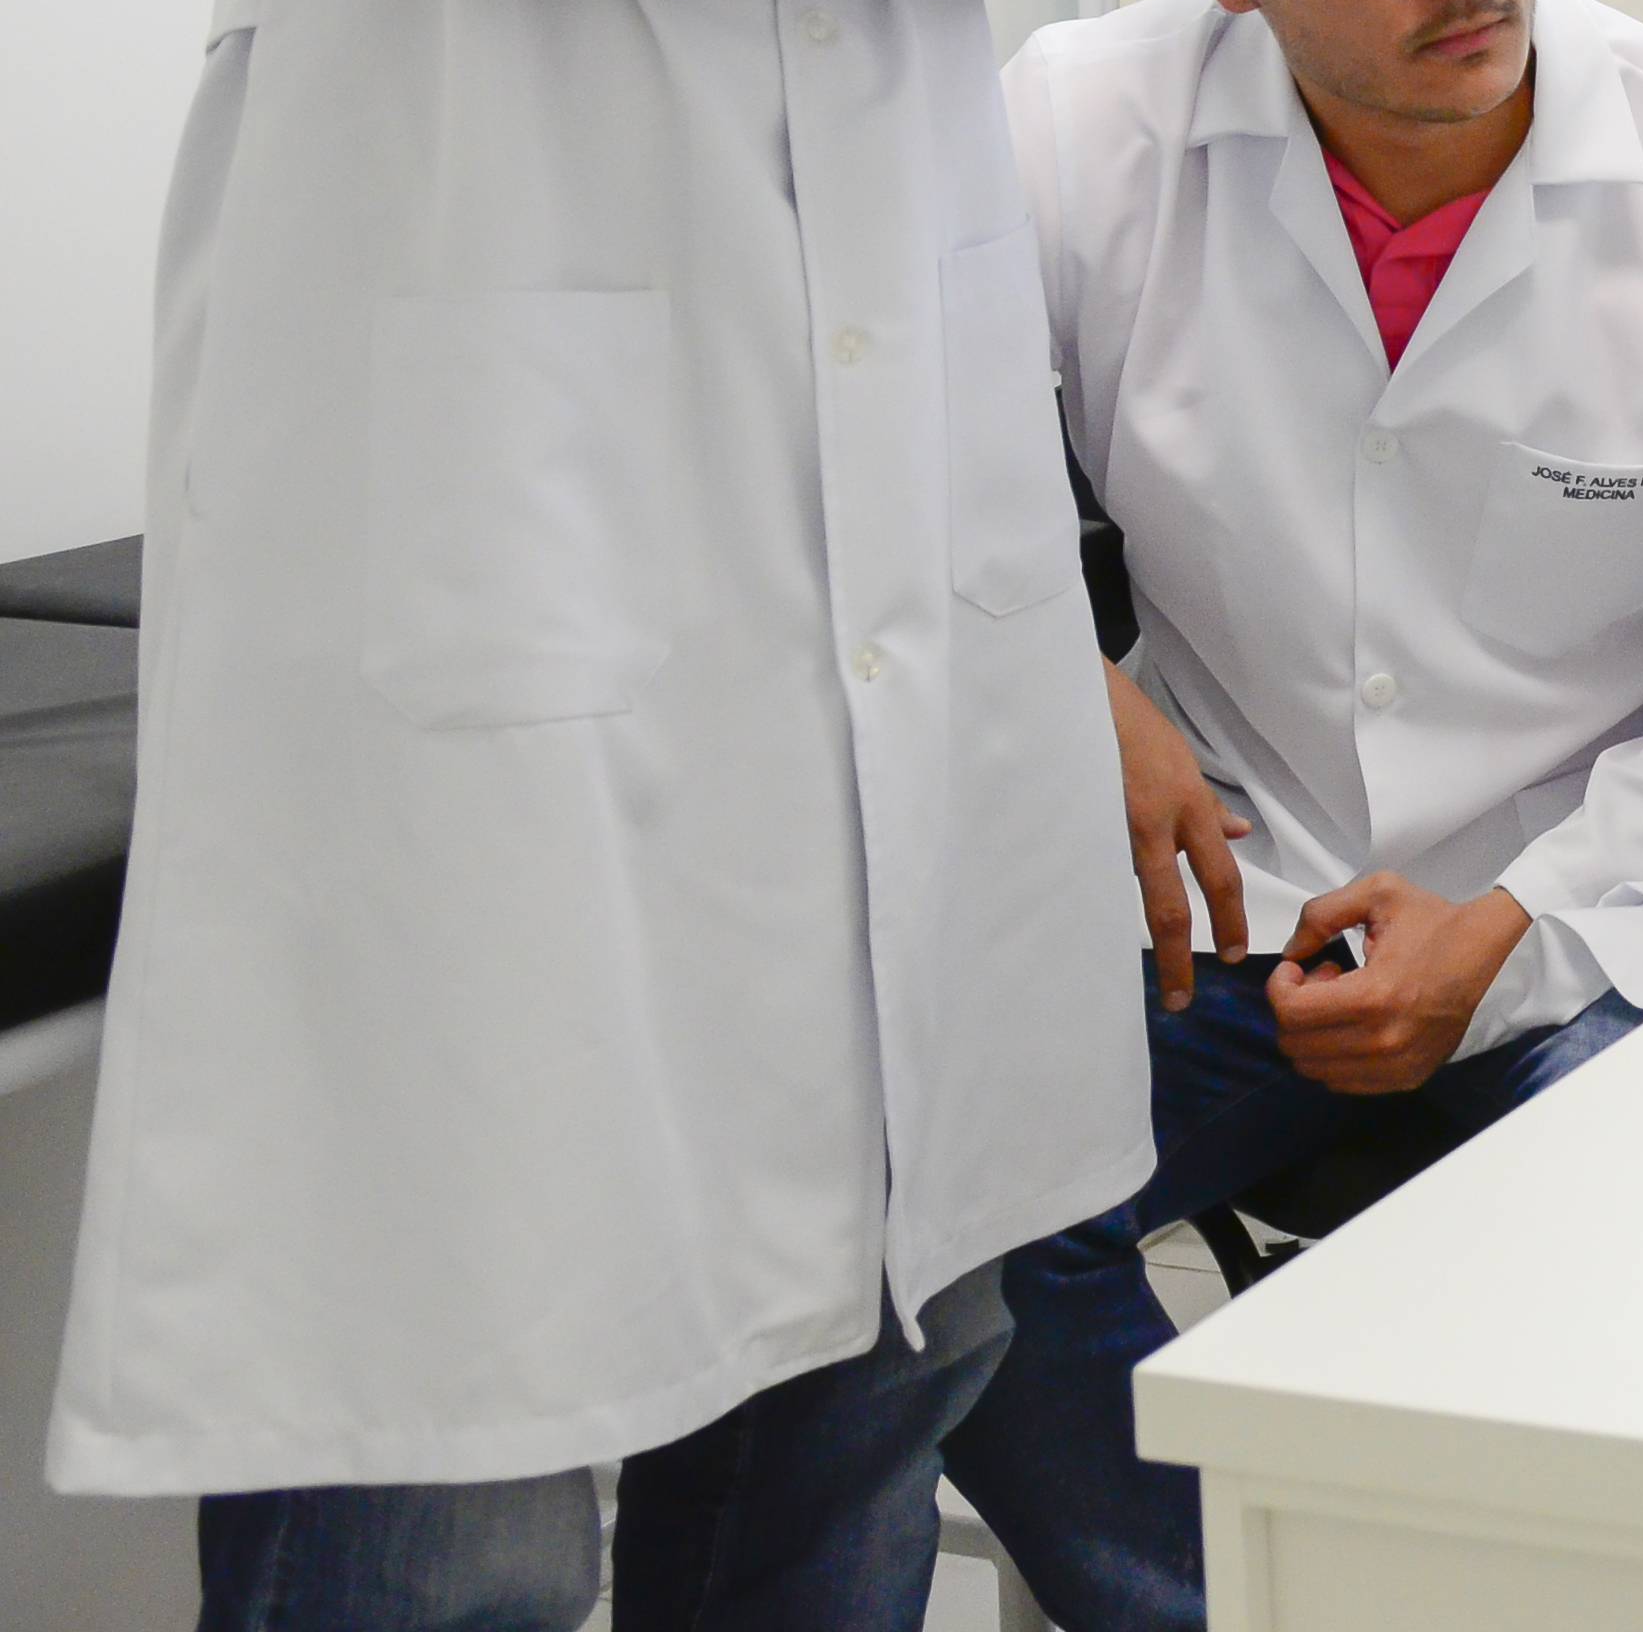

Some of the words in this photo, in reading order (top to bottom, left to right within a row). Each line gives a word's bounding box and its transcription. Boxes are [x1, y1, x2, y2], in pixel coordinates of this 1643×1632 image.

[1531, 466, 1572, 485] JOSÉ
[1575, 475, 1587, 487] F.
[1589, 477, 1637, 488] ALVES
[1562, 486, 1636, 500] MEDICINA
